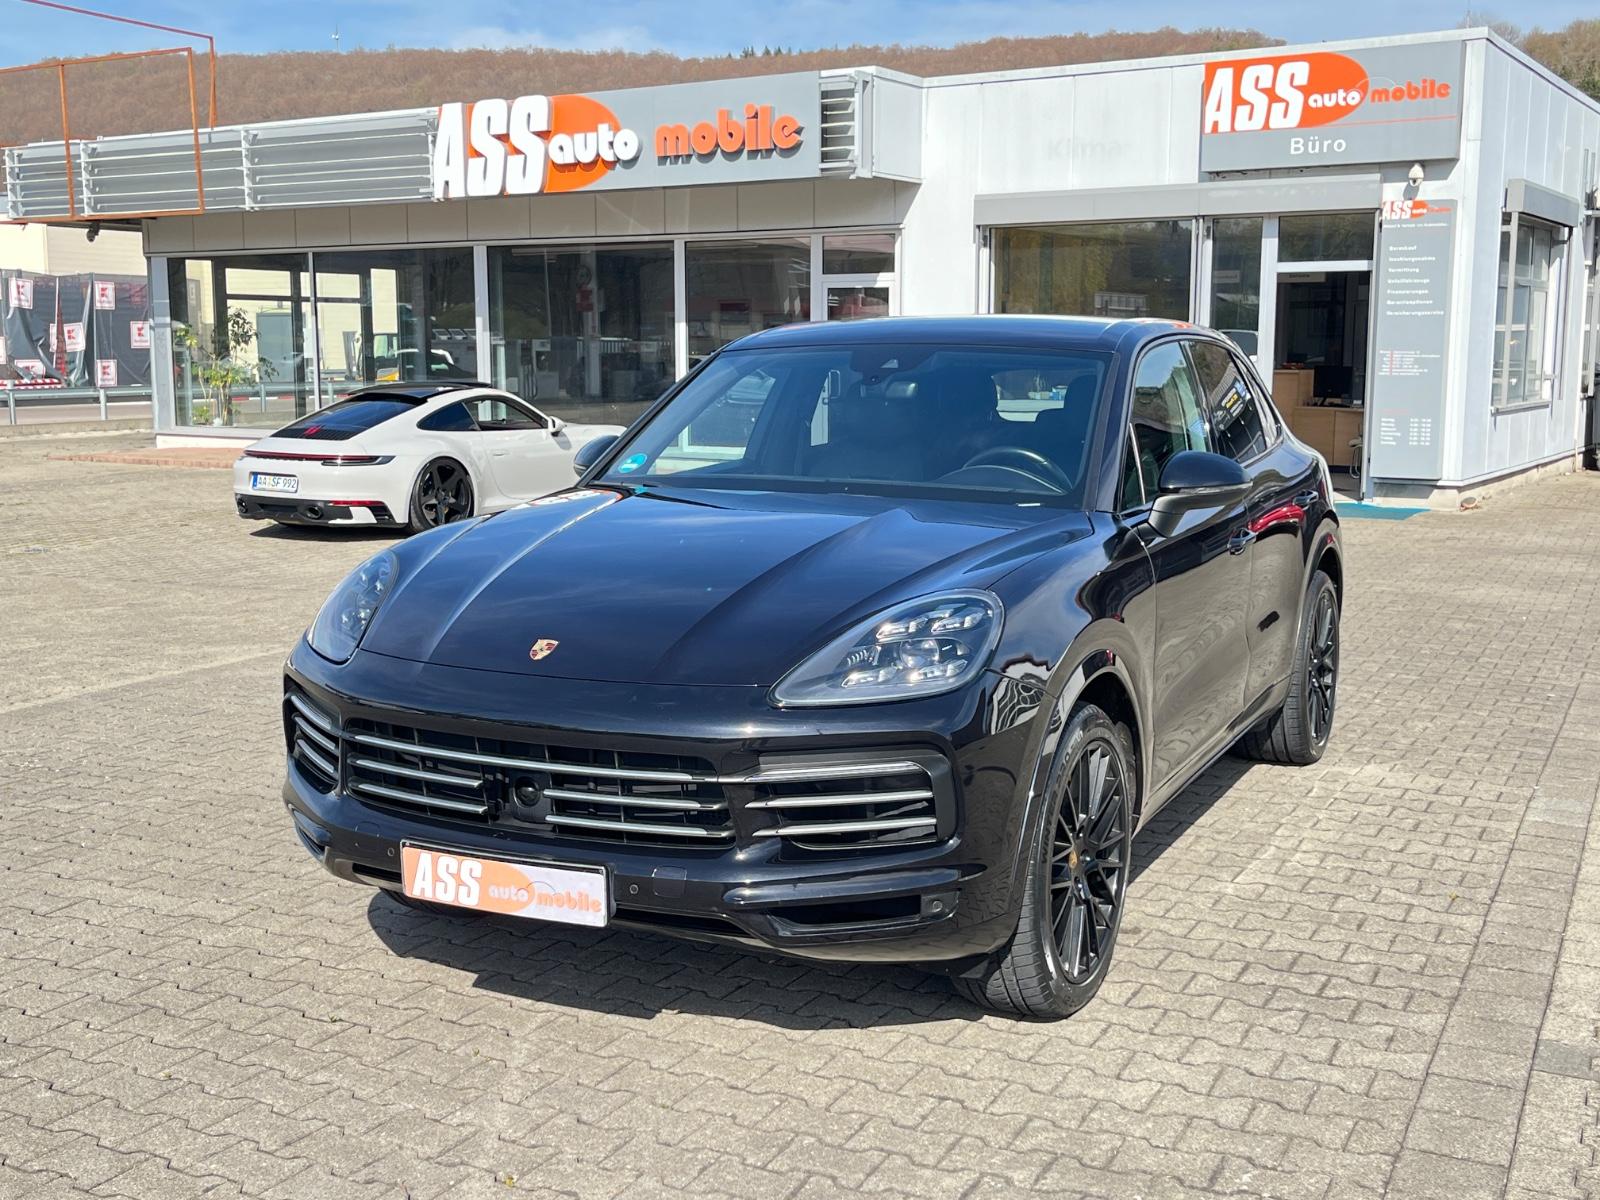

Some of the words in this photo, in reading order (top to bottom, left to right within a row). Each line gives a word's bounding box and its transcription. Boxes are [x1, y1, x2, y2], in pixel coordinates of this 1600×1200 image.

[1204, 61, 1310, 134] ASS
[1308, 88, 1361, 108] auto
[1370, 79, 1452, 104] mobile
[433, 95, 550, 198] ASS
[548, 123, 639, 165] auto
[655, 102, 802, 157] mobile
[1290, 137, 1347, 155] Büro
[1382, 201, 1413, 220] ASS
[271, 476, 282, 487] SF
[282, 478, 297, 489] 992
[412, 852, 482, 907] ASS
[488, 884, 529, 902] auto
[537, 890, 602, 913] mobile
